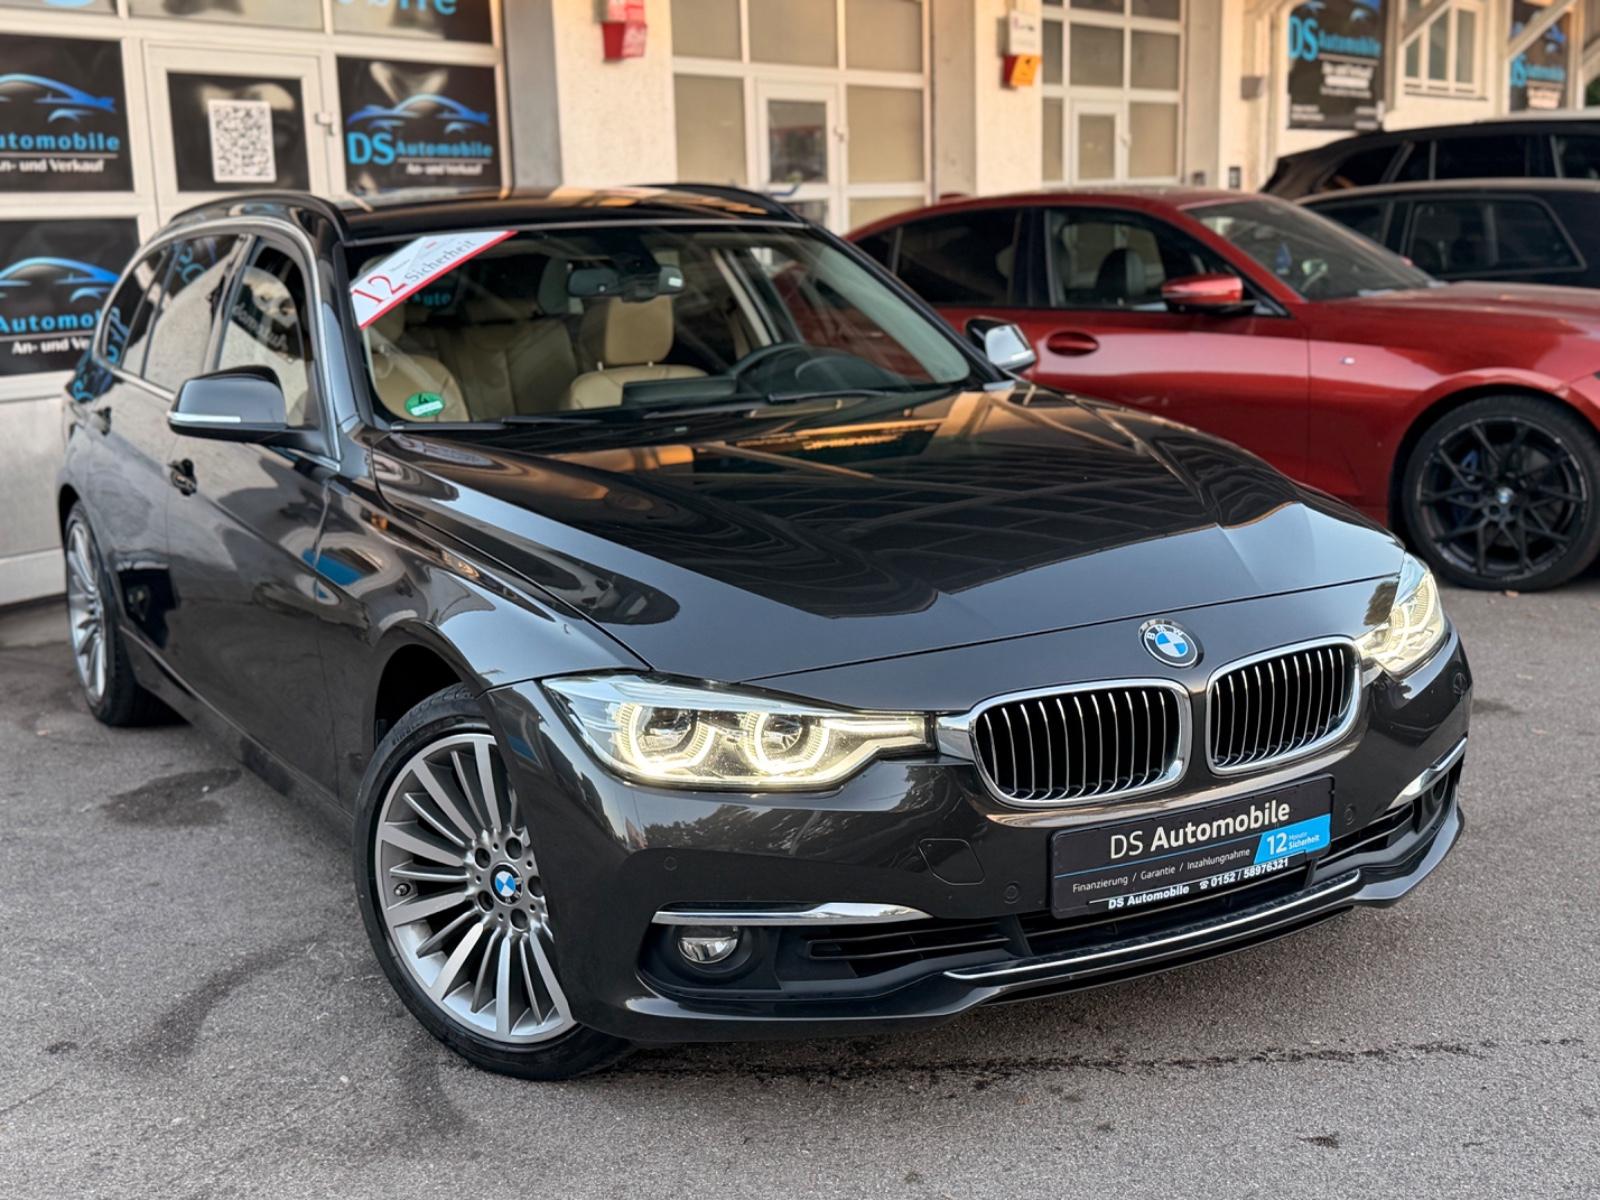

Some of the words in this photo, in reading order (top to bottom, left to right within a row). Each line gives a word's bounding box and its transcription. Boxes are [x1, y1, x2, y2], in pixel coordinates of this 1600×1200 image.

[19, 159, 48, 173] und
[48, 158, 105, 173] Verkauf
[347, 131, 395, 166] DS
[396, 140, 494, 158] Automobile
[352, 275, 408, 304] 12
[405, 239, 477, 283] Sicherheit
[40, 338, 70, 354] und
[1110, 830, 1144, 859] DS
[1150, 799, 1290, 852] Automobile
[1266, 832, 1288, 855] 12
[1289, 834, 1320, 849] Sicherheit
[1072, 874, 1129, 893] Finanzierung
[1140, 866, 1176, 880] Garantie
[1187, 848, 1251, 871] Inzahlungnahme
[1108, 896, 1125, 910] DS
[1127, 885, 1190, 906] Automobile
[1210, 872, 1235, 887] 0152
